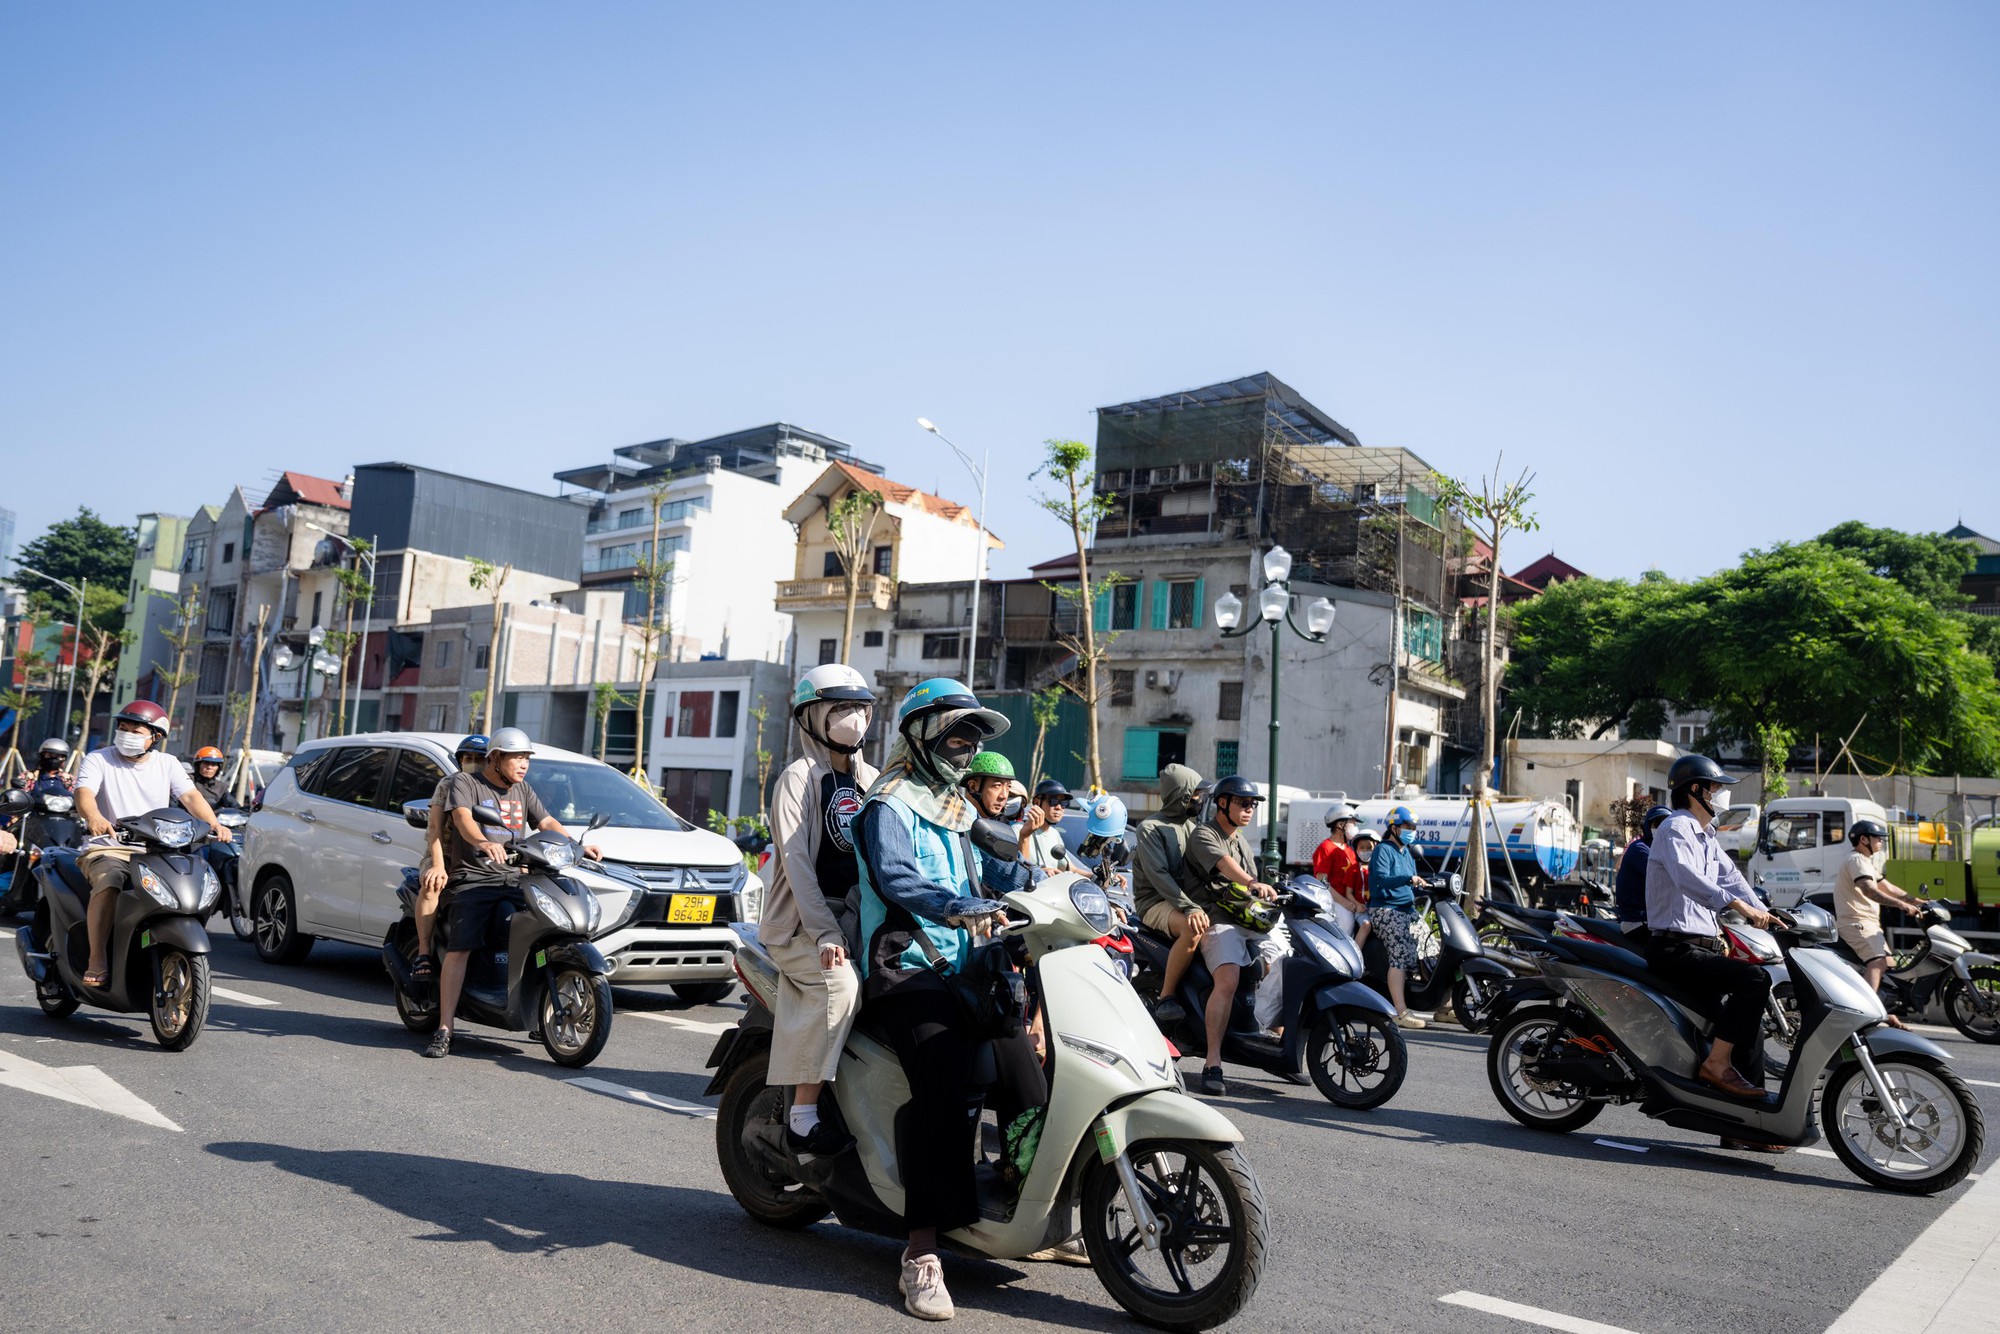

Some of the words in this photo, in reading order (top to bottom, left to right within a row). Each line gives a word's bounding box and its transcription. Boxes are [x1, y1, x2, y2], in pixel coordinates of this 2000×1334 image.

[917, 687, 929, 696] SM
[834, 832, 853, 850] STREET
[1429, 830, 1440, 842] 93
[683, 896, 704, 908] 29H
[673, 909, 709, 922] 964.38
